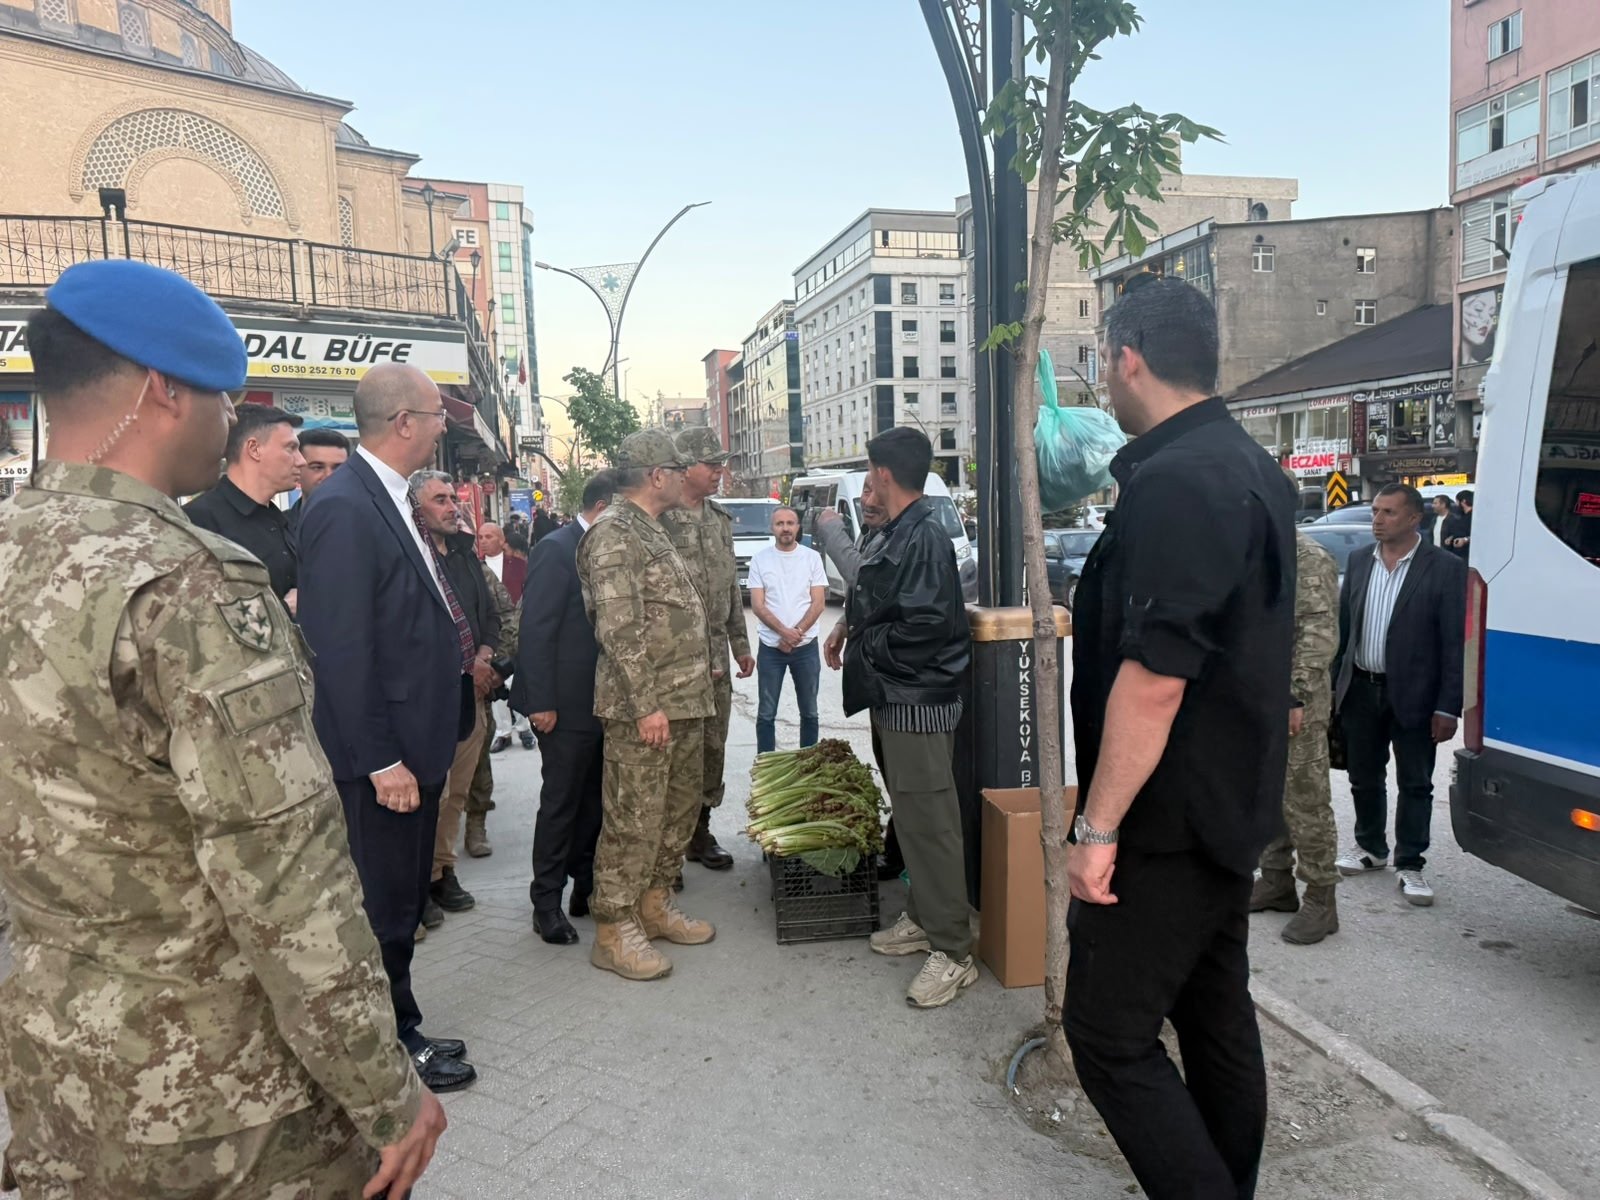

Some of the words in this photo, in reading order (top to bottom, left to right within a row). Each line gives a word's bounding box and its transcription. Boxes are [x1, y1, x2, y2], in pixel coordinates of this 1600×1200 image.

[323, 333, 412, 364] BÜFE
[281, 365, 306, 374] 0530
[309, 366, 328, 375] 252
[330, 367, 342, 376] 76
[344, 367, 356, 376] 70
[1375, 387, 1413, 399] Jaguar
[1291, 453, 1335, 469] ECZANE
[16, 467, 28, 475] 05
[1304, 468, 1321, 476] SANAT
[1018, 641, 1032, 762] YÜKSEKOVA
